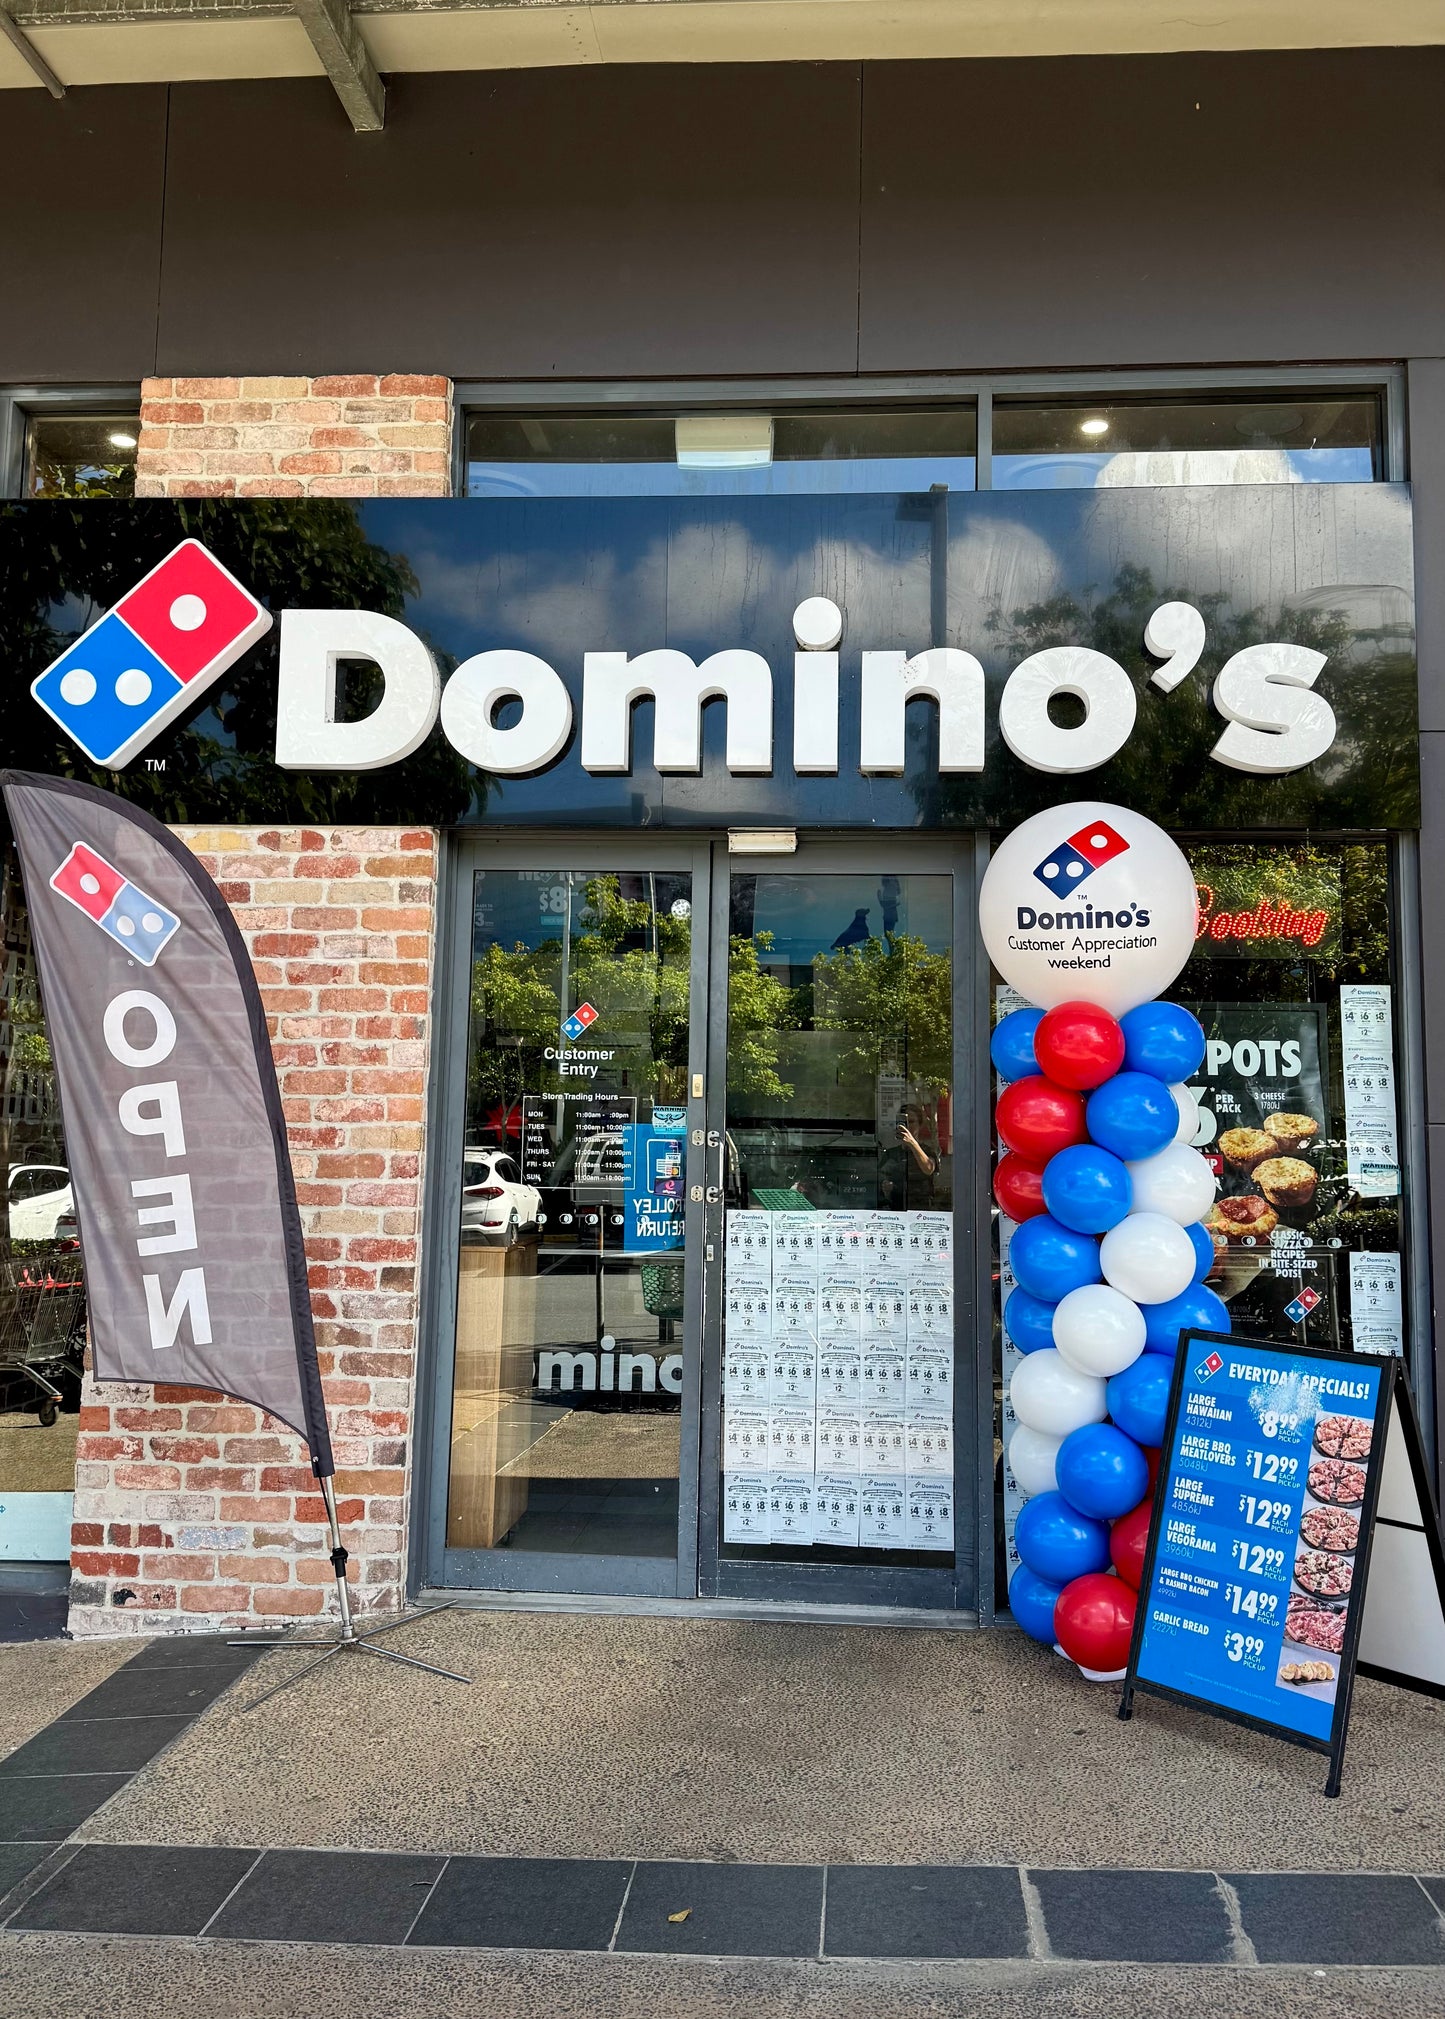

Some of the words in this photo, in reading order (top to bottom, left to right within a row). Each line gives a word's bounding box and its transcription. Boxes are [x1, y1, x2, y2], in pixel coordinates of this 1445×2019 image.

[275, 597, 1336, 774] Domino's
[144, 759, 167, 772] TM
[1017, 902, 1151, 931] Domino's
[1008, 936, 1065, 951] Customer
[1072, 935, 1157, 953] Appreciation
[1048, 955, 1111, 969] weekend
[543, 1048, 615, 1060] Customer
[1206, 1039, 1302, 1077] POTS
[559, 1062, 598, 1079] Entry
[542, 1092, 563, 1100] Store
[564, 1093, 592, 1102] Trading
[595, 1093, 619, 1101] Hours
[1215, 1094, 1234, 1103] PER
[1254, 1092, 1259, 1100] 3
[1261, 1092, 1285, 1100] CHEESE
[1216, 1104, 1241, 1113] PACK
[1271, 1231, 1304, 1239] CLASSIC
[1270, 1250, 1306, 1259] RECIPES
[1259, 1259, 1268, 1267] IN
[1271, 1259, 1318, 1269] BITE-SIZED
[1276, 1269, 1302, 1278] POTS!
[1302, 1375, 1370, 1400] SPECIALS!
[1188, 1393, 1216, 1406] LARGE
[1187, 1404, 1232, 1421] HAWAIIAN
[1278, 1428, 1295, 1437] EACH
[1182, 1434, 1210, 1449] LARGE
[1212, 1440, 1231, 1454] BBQ
[1278, 1435, 1291, 1444] PICK
[1180, 1446, 1236, 1467] MEATLOVERS
[1178, 1457, 1208, 1472] 5048kJ
[1279, 1473, 1295, 1481] EACH
[1175, 1476, 1203, 1492] LARGE
[1278, 1480, 1292, 1488] PICK
[1173, 1488, 1215, 1507] SUPREME
[1172, 1501, 1202, 1515] 4856kJ
[1168, 1519, 1196, 1536] LARGE
[1270, 1525, 1285, 1533] PICK
[1272, 1519, 1289, 1527] EACH
[1167, 1530, 1217, 1553] VEGORAMA
[1265, 1565, 1282, 1574] EACH
[1160, 1566, 1179, 1578] LARGE
[1180, 1570, 1193, 1583] BBQ
[1194, 1575, 1219, 1589] CHICKEN
[1264, 1572, 1278, 1580] PICK
[1166, 1578, 1188, 1591] RASHER
[1189, 1584, 1210, 1597] BACON
[1258, 1609, 1275, 1619] EACH
[1153, 1610, 1181, 1627] GARLIC
[1182, 1619, 1210, 1635] BREAD
[1257, 1616, 1271, 1625] PICK
[1244, 1653, 1261, 1663] EACH
[1243, 1661, 1256, 1669] PICK
